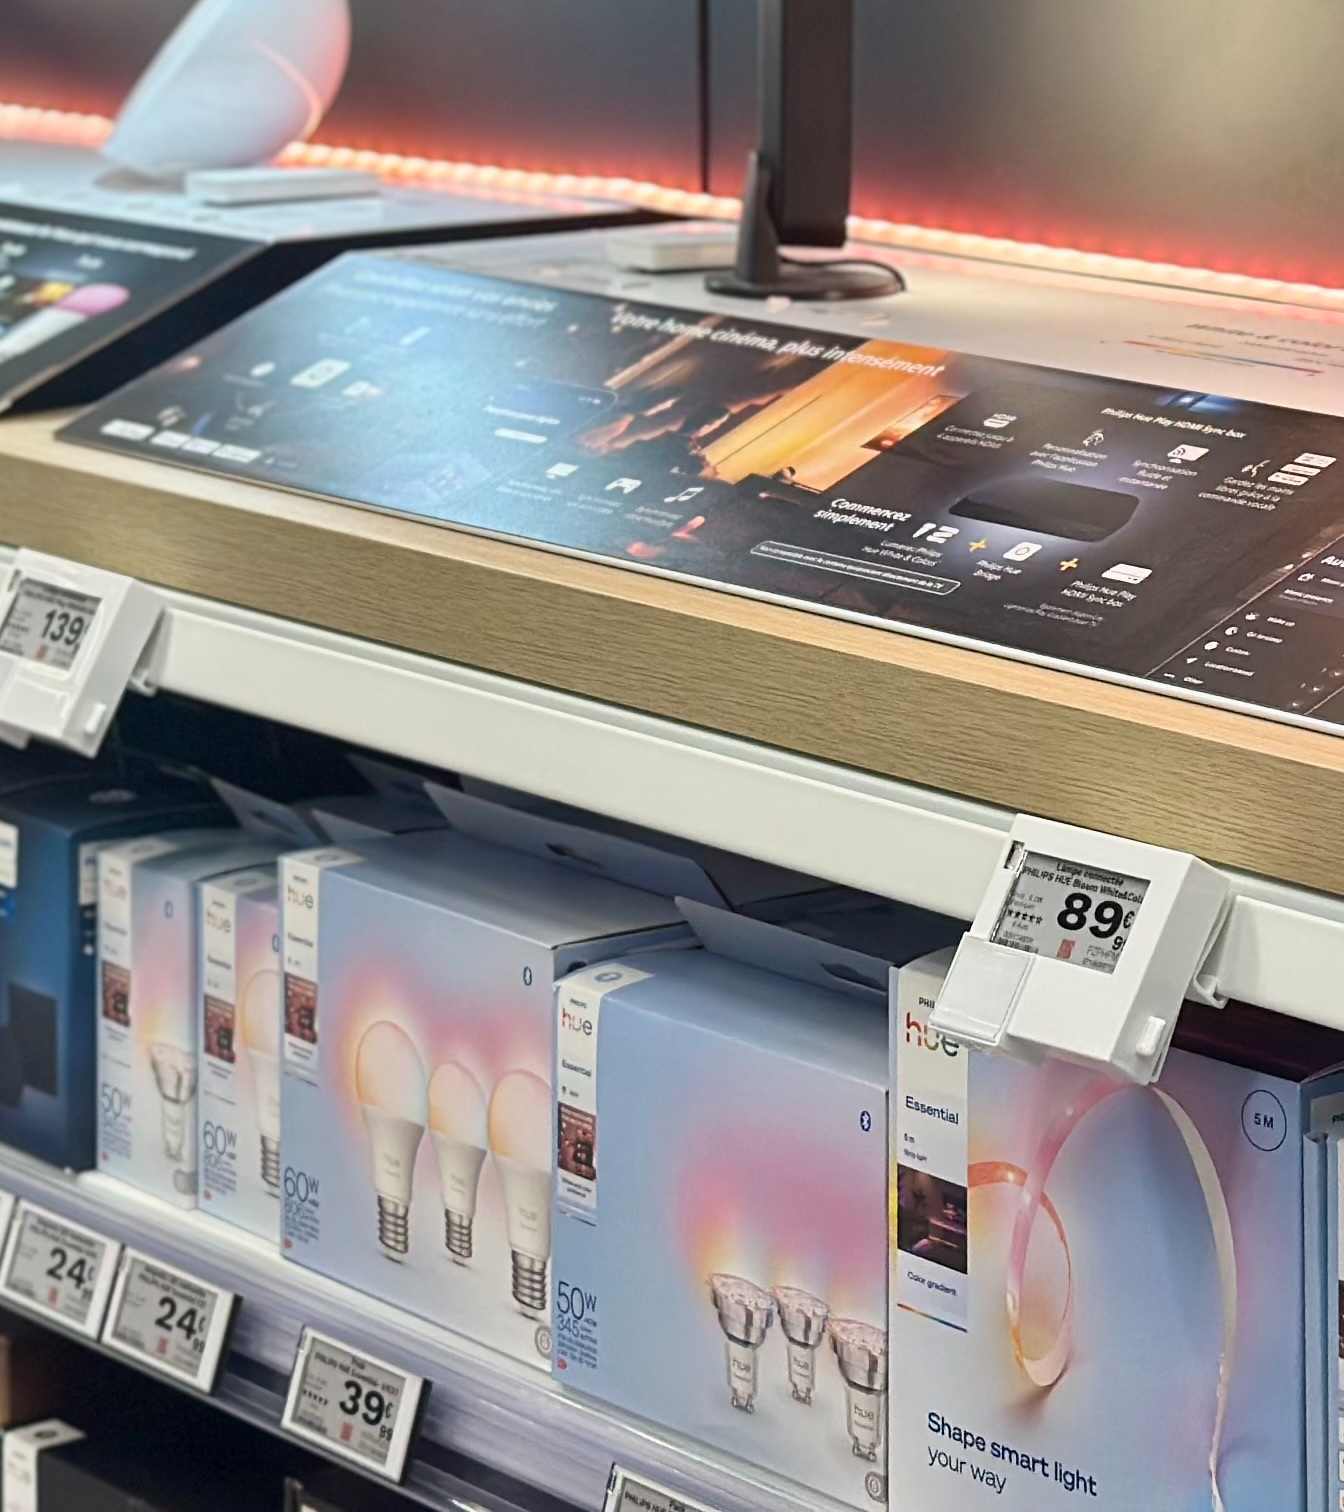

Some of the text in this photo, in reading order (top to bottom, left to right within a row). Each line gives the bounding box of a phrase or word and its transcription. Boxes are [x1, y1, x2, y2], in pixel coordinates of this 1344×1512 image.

[611, 310, 945, 378] Votre home cinéma, plus intensément
[1101, 407, 1247, 438] Philips Hue Play HDMI Sync box
[813, 509, 896, 532] simplement
[831, 498, 912, 522] Commencez
[41, 609, 84, 646] 139
[1021, 866, 1055, 882] PHILIPS
[1055, 874, 1072, 886] HUE
[1056, 862, 1083, 877] Lampe
[288, 884, 314, 909] hue
[562, 1006, 593, 1036] hue
[906, 1095, 959, 1125] Essential
[1254, 1113, 1274, 1129] 5 M
[204, 1120, 237, 1156] 60W
[284, 1166, 319, 1203] 60W
[557, 1280, 597, 1321] 50W
[557, 1314, 580, 1338] 345
[854, 1403, 875, 1421] hue
[927, 1411, 1098, 1497] Shape smart light
[928, 1446, 1007, 1494] your way
